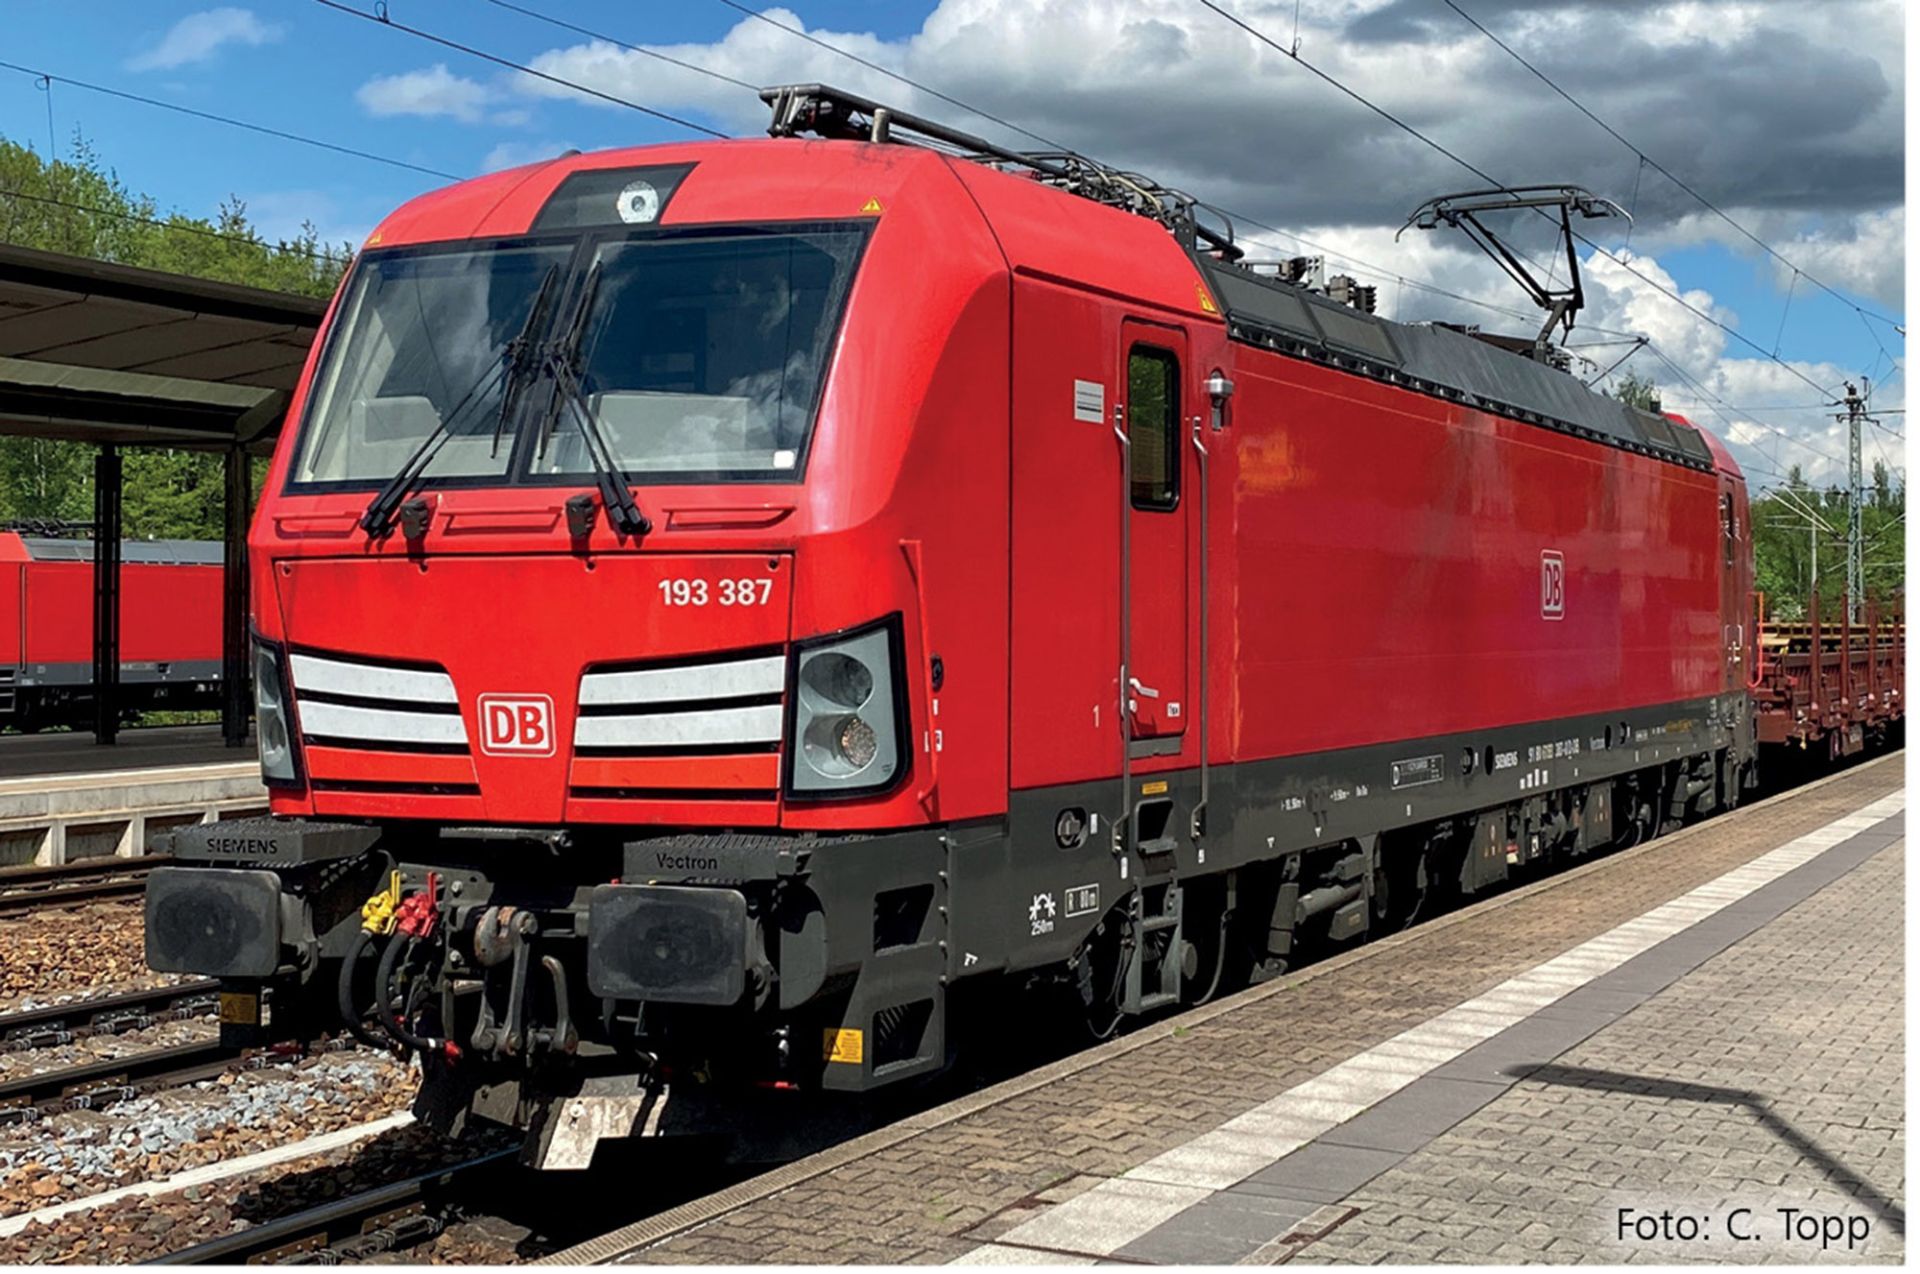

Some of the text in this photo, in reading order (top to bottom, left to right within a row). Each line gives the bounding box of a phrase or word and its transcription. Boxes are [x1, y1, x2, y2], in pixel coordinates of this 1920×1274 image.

[658, 578, 774, 606] 193 387
[1545, 562, 1561, 607] DB
[488, 704, 545, 745] DB
[1092, 704, 1100, 728] 1
[207, 837, 278, 855] SIEMENS
[656, 852, 718, 870] Vectron
